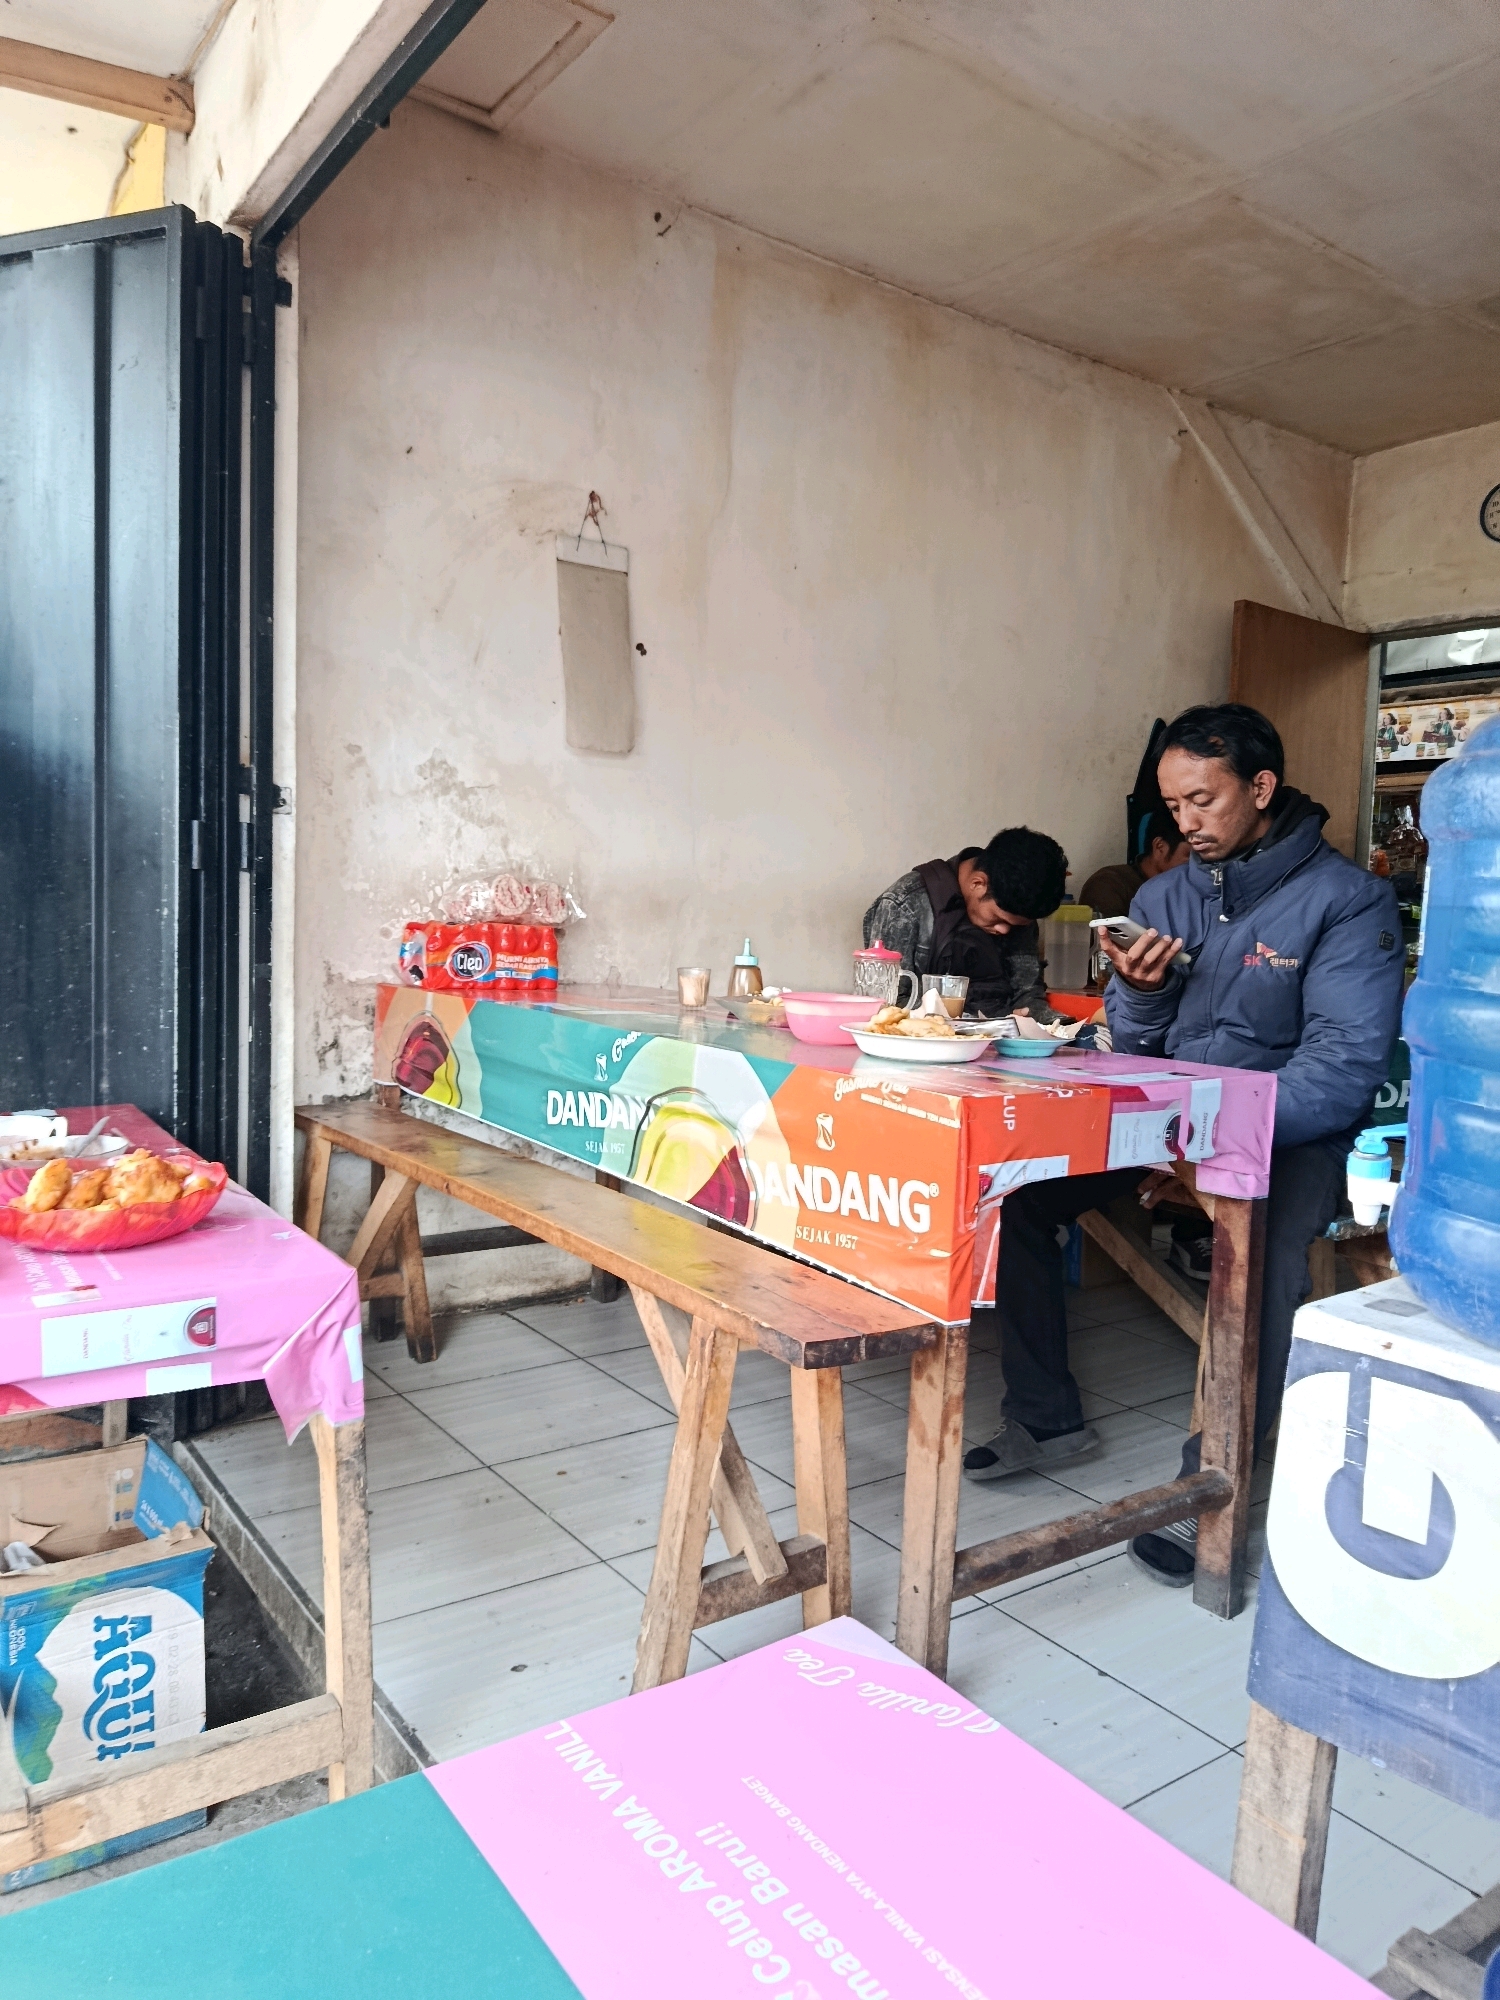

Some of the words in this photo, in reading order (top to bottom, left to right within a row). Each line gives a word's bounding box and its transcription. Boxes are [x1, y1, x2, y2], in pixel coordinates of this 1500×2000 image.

[457, 954, 482, 971] Cleo
[1244, 955, 1262, 966] SK
[547, 1090, 662, 1131] DANDAN
[585, 1140, 608, 1154] SEJAK
[610, 1142, 626, 1155] 1957
[1200, 1113, 1209, 1151] DANDANG
[795, 1225, 831, 1245] SEJAK
[834, 1231, 860, 1250] 1957
[783, 1648, 856, 1687] Tea
[857, 1681, 1001, 1734] Vanilla
[740, 1775, 792, 1818] BANGET
[612, 1795, 717, 1893] AROMA
[786, 1816, 850, 1884] NENDANG
[845, 1871, 926, 1950] VANILA-NYA
[706, 1894, 791, 1985] Celup
[922, 1946, 989, 2000] ENSASI
